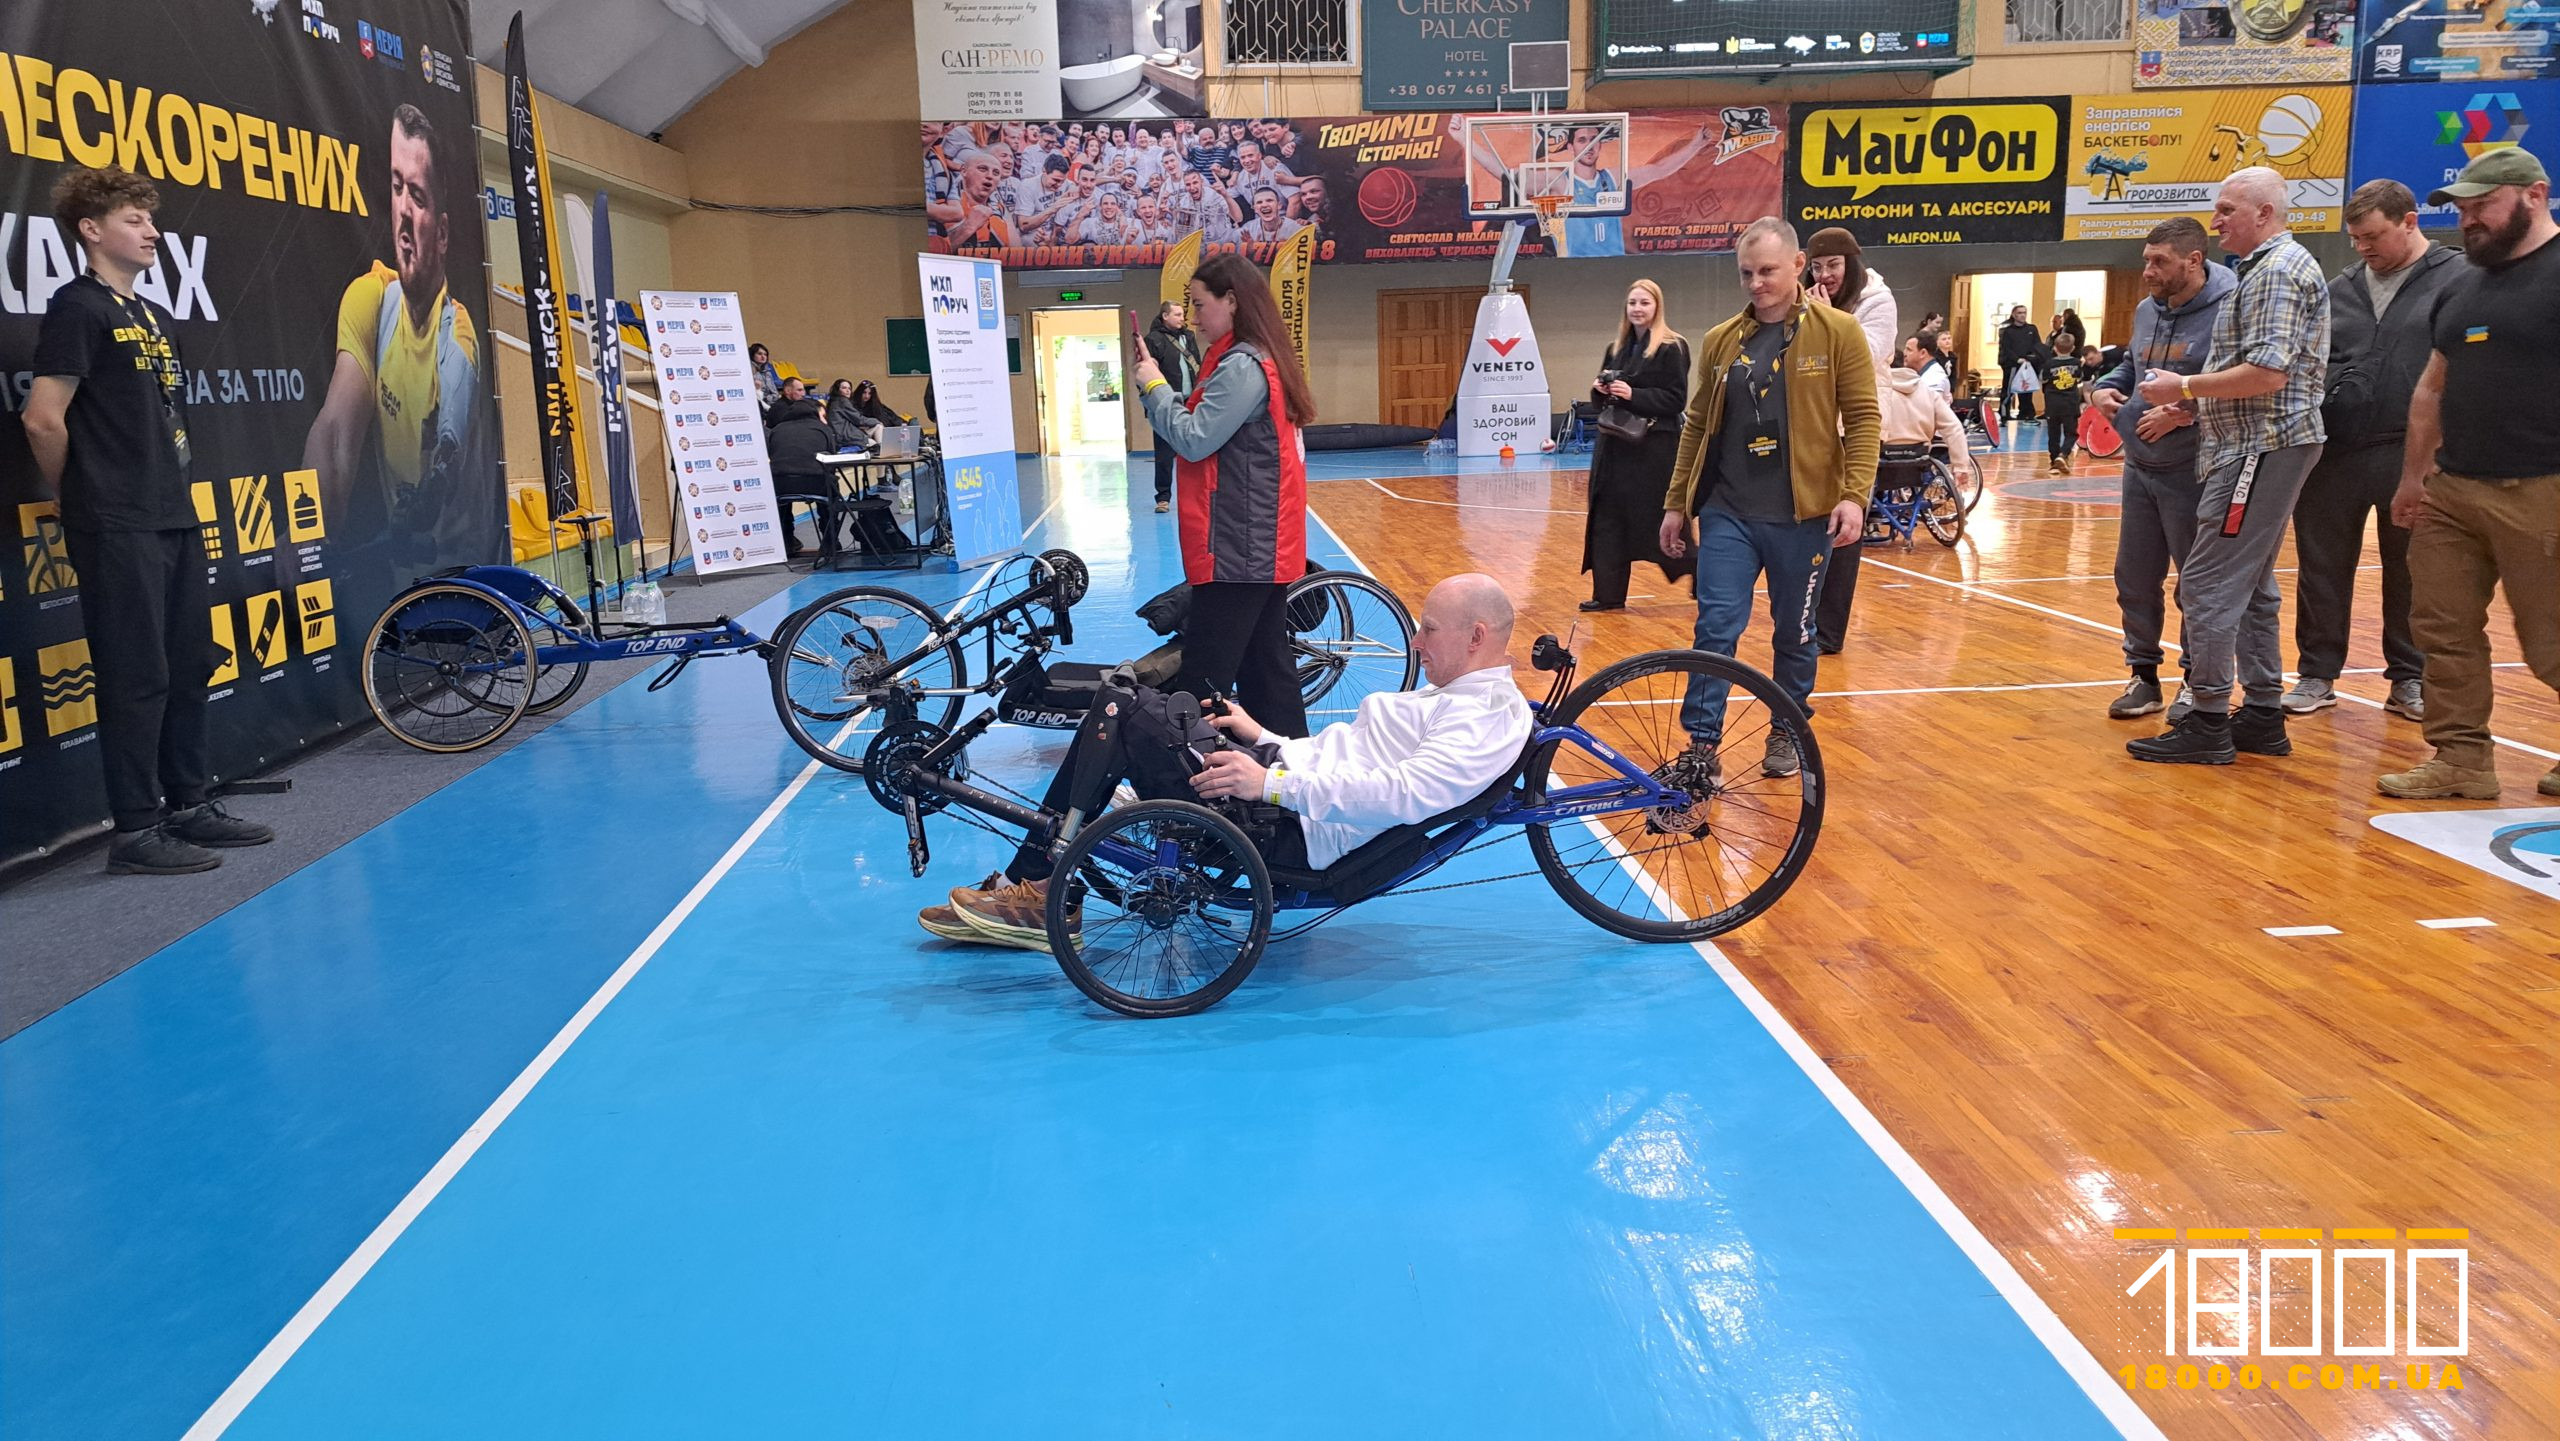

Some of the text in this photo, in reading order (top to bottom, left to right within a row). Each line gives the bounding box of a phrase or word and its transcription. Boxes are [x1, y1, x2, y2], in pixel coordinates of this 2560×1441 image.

[1420, 18, 1512, 39] PALACE
[1445, 51, 1488, 62] HOTEL
[1388, 85, 1418, 95] +38
[1426, 84, 1456, 95] 067
[1464, 84, 1492, 95] 461
[2085, 105, 2182, 121] Заправляйся
[2085, 120, 2151, 134] енергією
[1802, 200, 2051, 220] СМАРТФОНИ ТА АКСЕСУАРИ
[1634, 225, 1683, 237] ГРАВЕЦЬ
[1684, 222, 1731, 235] ЗБІРНОЇ
[1390, 233, 1454, 245] СВЯТОСЛАВ
[1656, 239, 1679, 250] LOS
[1887, 231, 1962, 244] MAIFON.UA
[930, 275, 953, 292] МХП
[1472, 361, 1535, 373] VENETO
[1482, 374, 1523, 383] SINCE 1993
[218, 369, 250, 404] ЗА
[252, 368, 305, 402] ТІЛО
[1491, 403, 1518, 414] ВАШ
[1472, 414, 1536, 429] ЗДОРОВИЙ
[1491, 431, 1518, 442] СОН
[624, 636, 687, 653] TOP END
[1011, 708, 1068, 726] TOP END
[1554, 799, 1625, 816] CATRIKE
